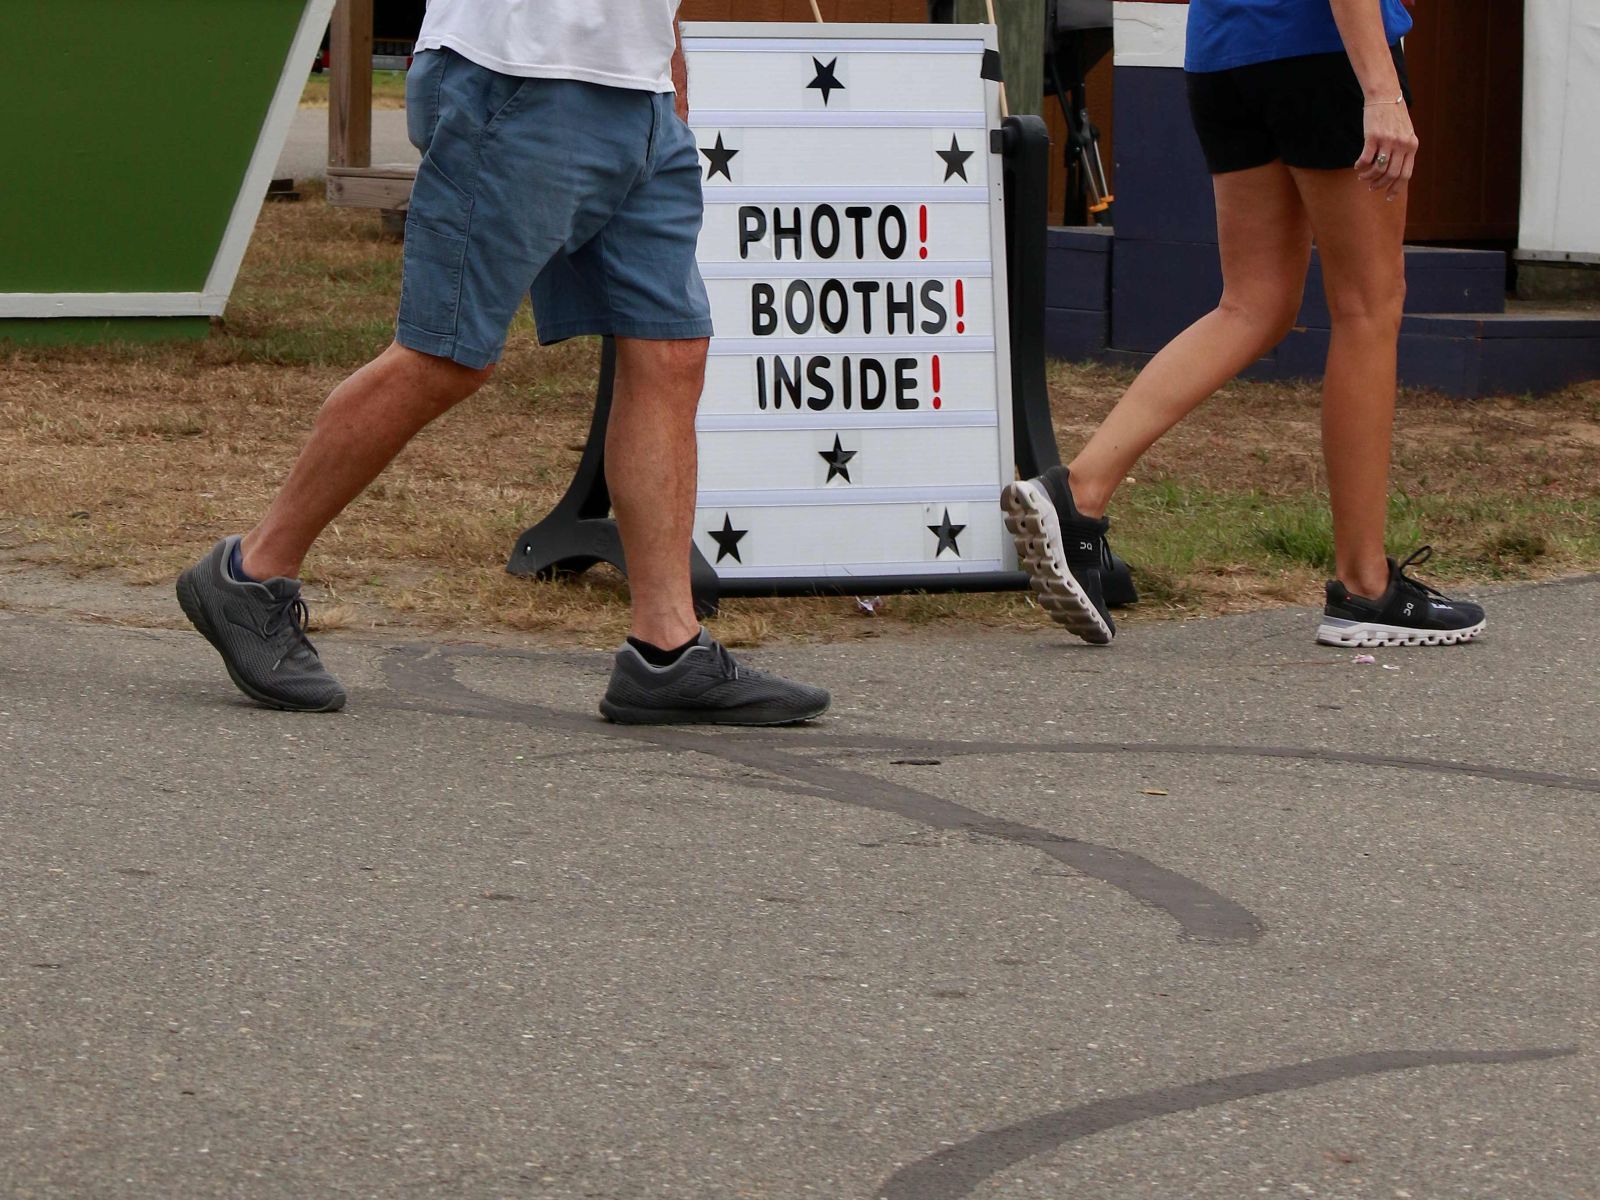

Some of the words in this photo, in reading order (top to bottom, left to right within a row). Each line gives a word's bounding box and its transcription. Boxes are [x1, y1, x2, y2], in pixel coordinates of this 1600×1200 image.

[738, 203, 928, 260] PHOTO!
[751, 278, 965, 336] BOOTHS!
[756, 354, 942, 411] INSIDE!
